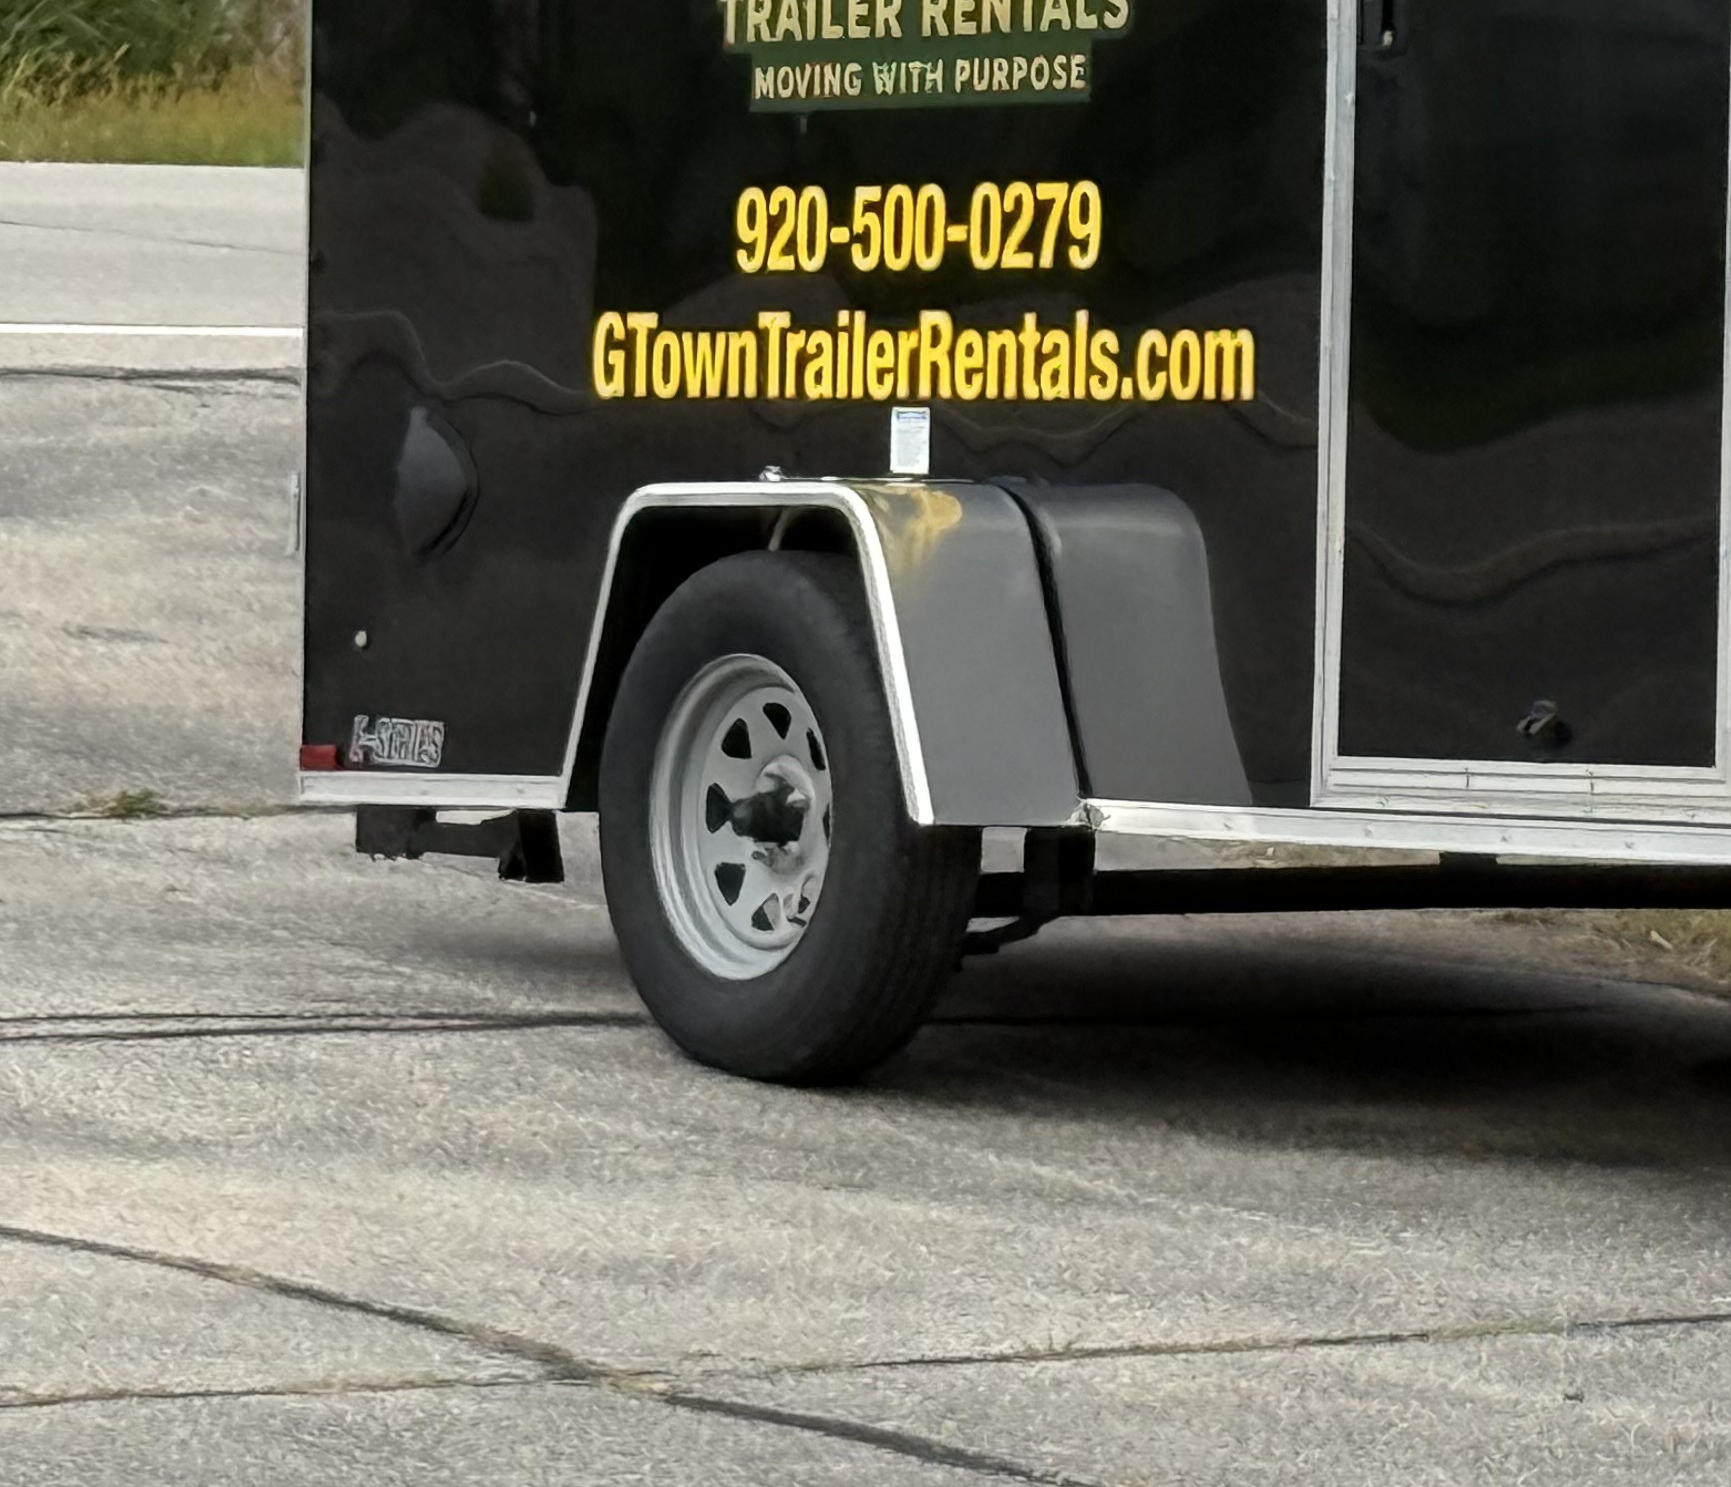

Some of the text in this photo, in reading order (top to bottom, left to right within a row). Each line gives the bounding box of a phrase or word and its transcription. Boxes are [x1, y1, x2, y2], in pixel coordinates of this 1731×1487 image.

[754, 53, 1087, 100] MOVING WITH PURPOSE
[735, 179, 1103, 274] 920-500-0279
[591, 309, 1256, 402] GTownTrailerRentals.com
